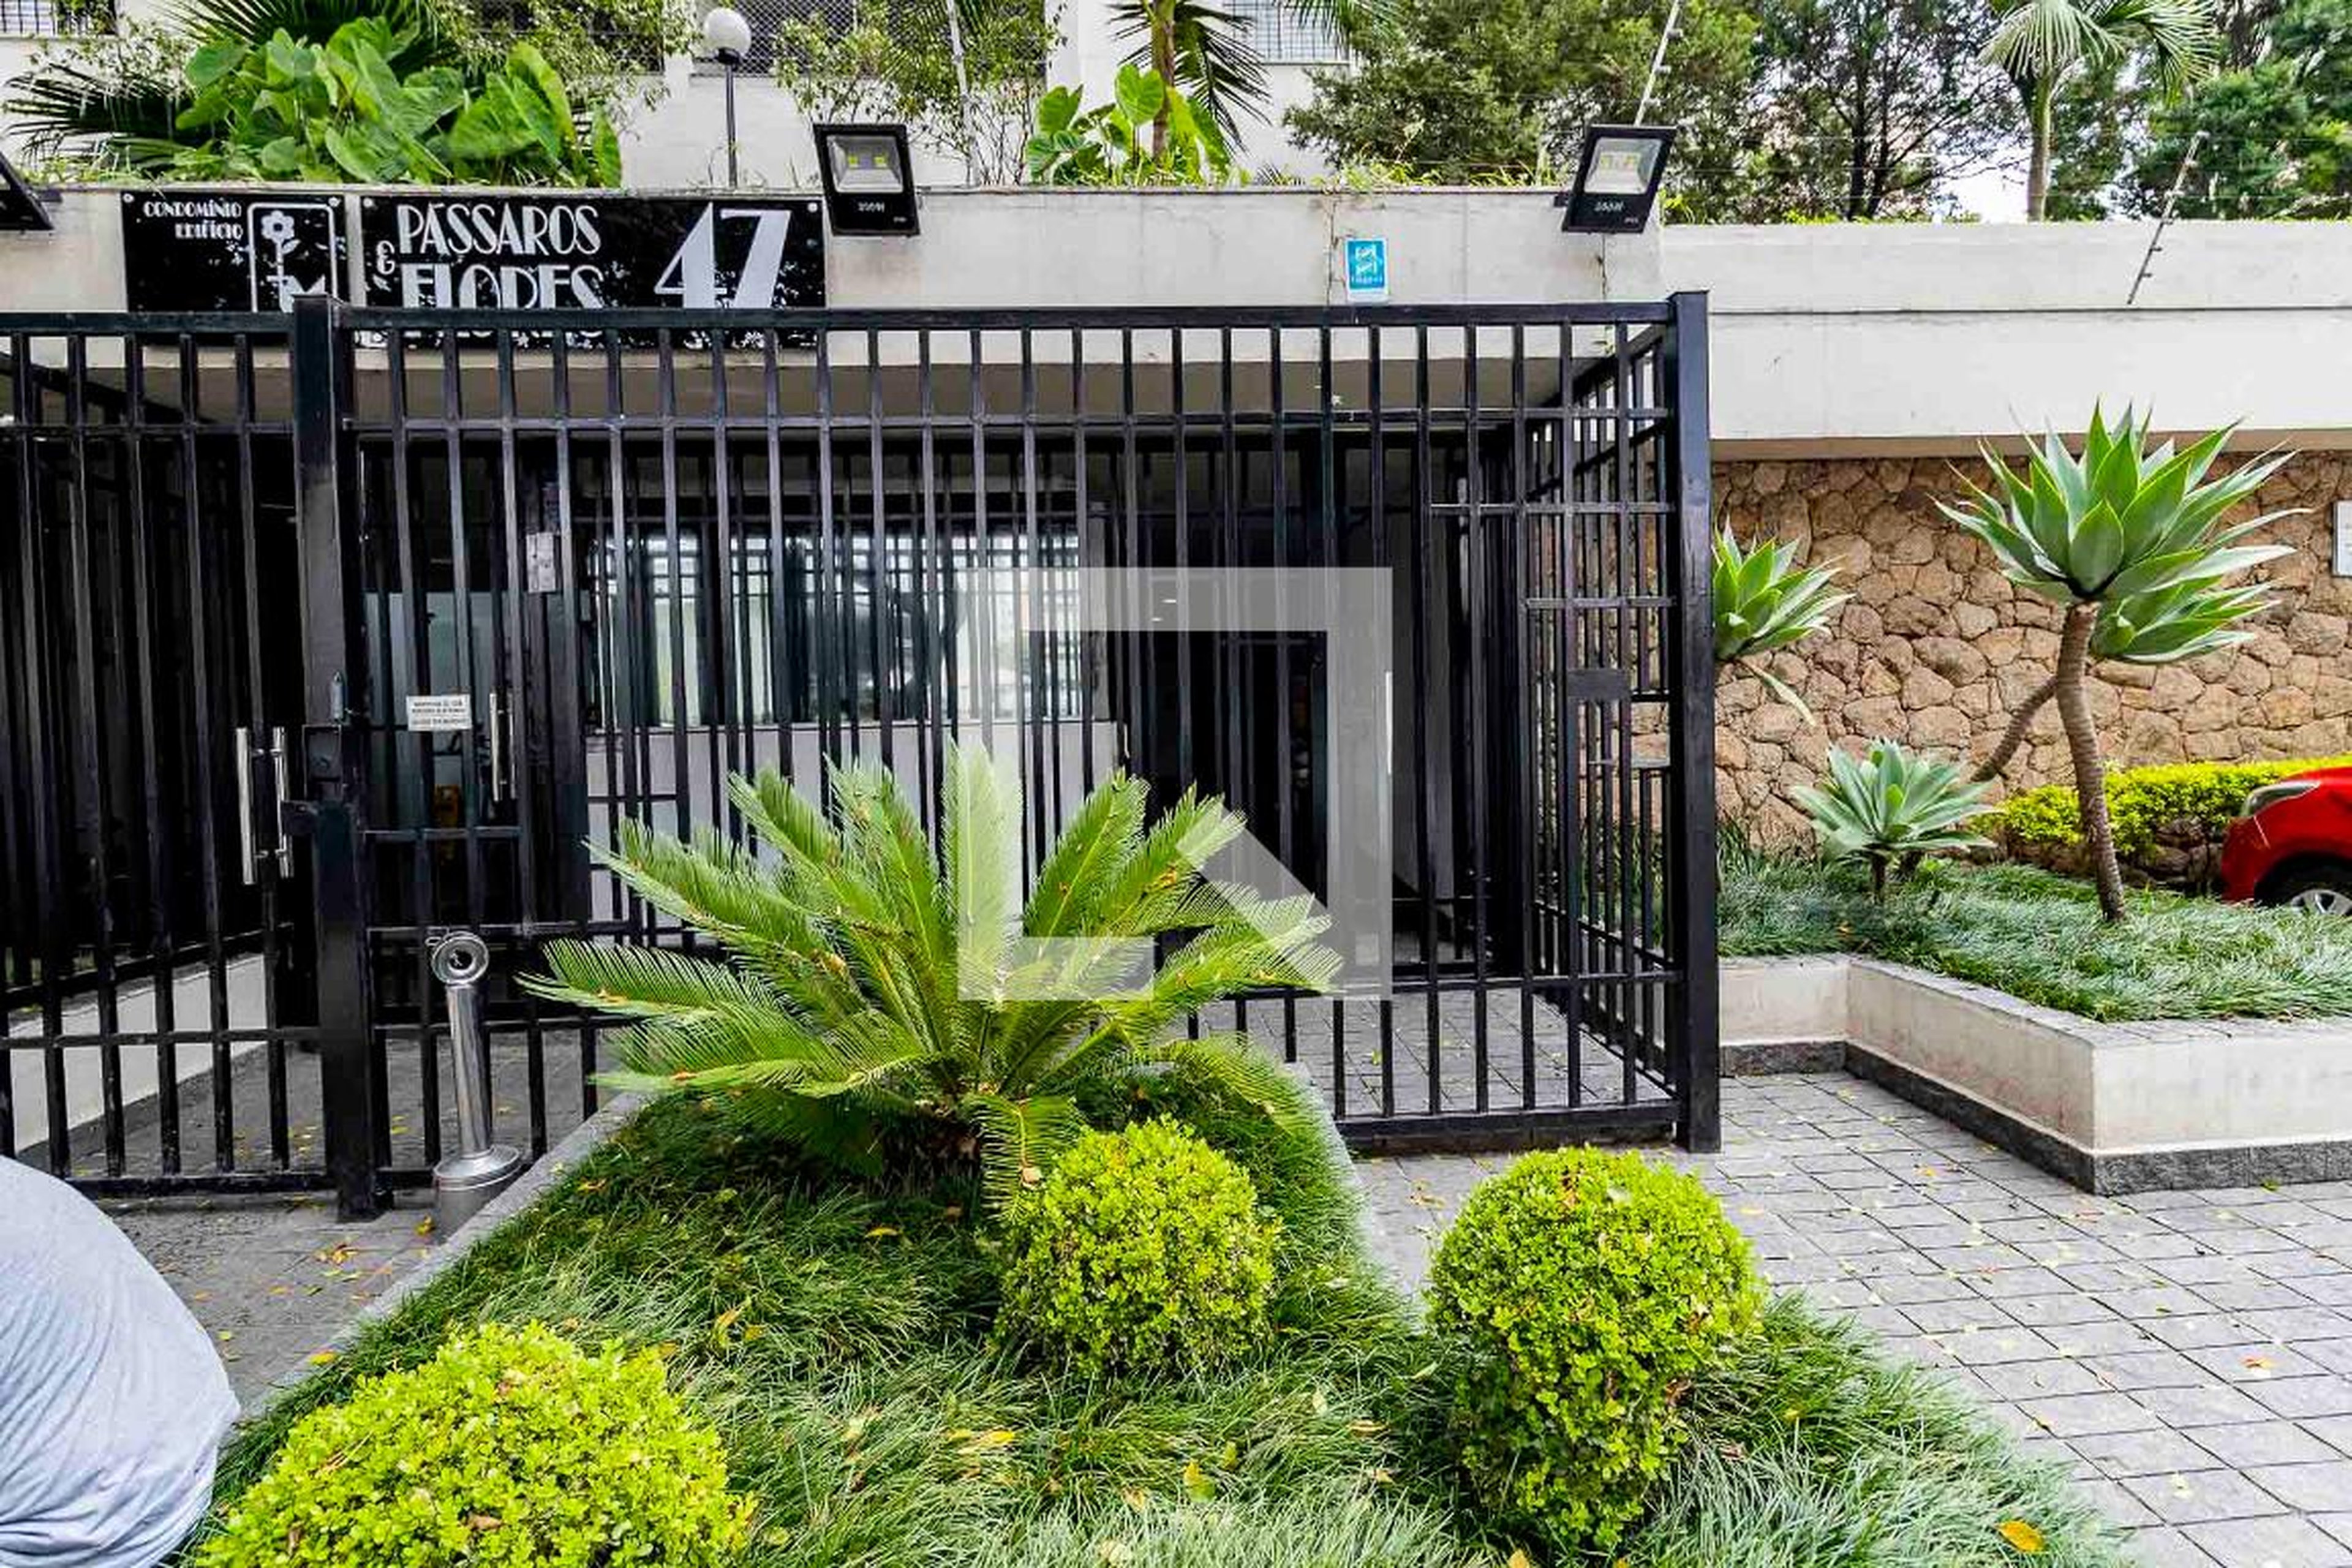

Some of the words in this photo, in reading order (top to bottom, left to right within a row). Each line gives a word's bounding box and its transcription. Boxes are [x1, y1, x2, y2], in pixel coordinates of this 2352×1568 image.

[143, 200, 242, 217] CONDOMÍNIO
[397, 203, 602, 255] PÁSSAROS
[654, 202, 791, 309] 47
